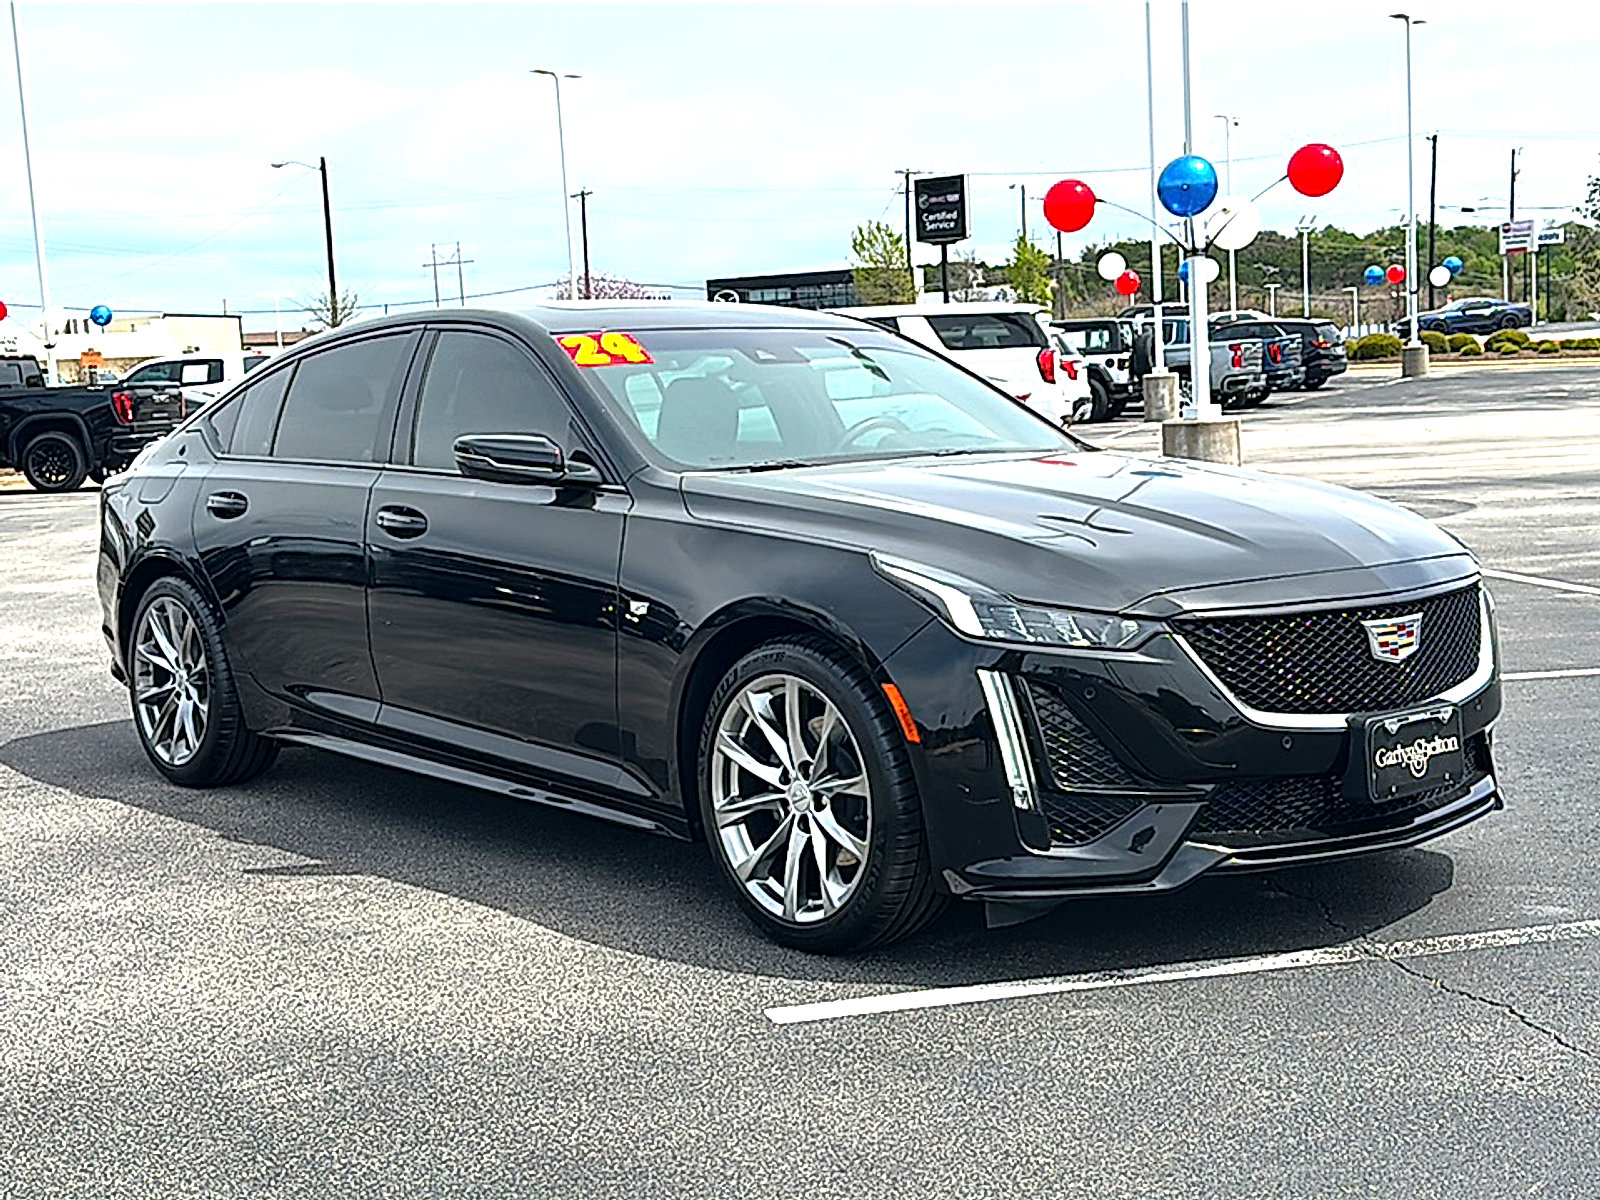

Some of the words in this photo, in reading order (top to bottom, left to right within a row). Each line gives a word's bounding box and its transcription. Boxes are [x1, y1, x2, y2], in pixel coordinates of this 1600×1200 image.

[922, 210, 958, 222] Certified
[925, 221, 955, 231] Service
[560, 332, 648, 365] 24
